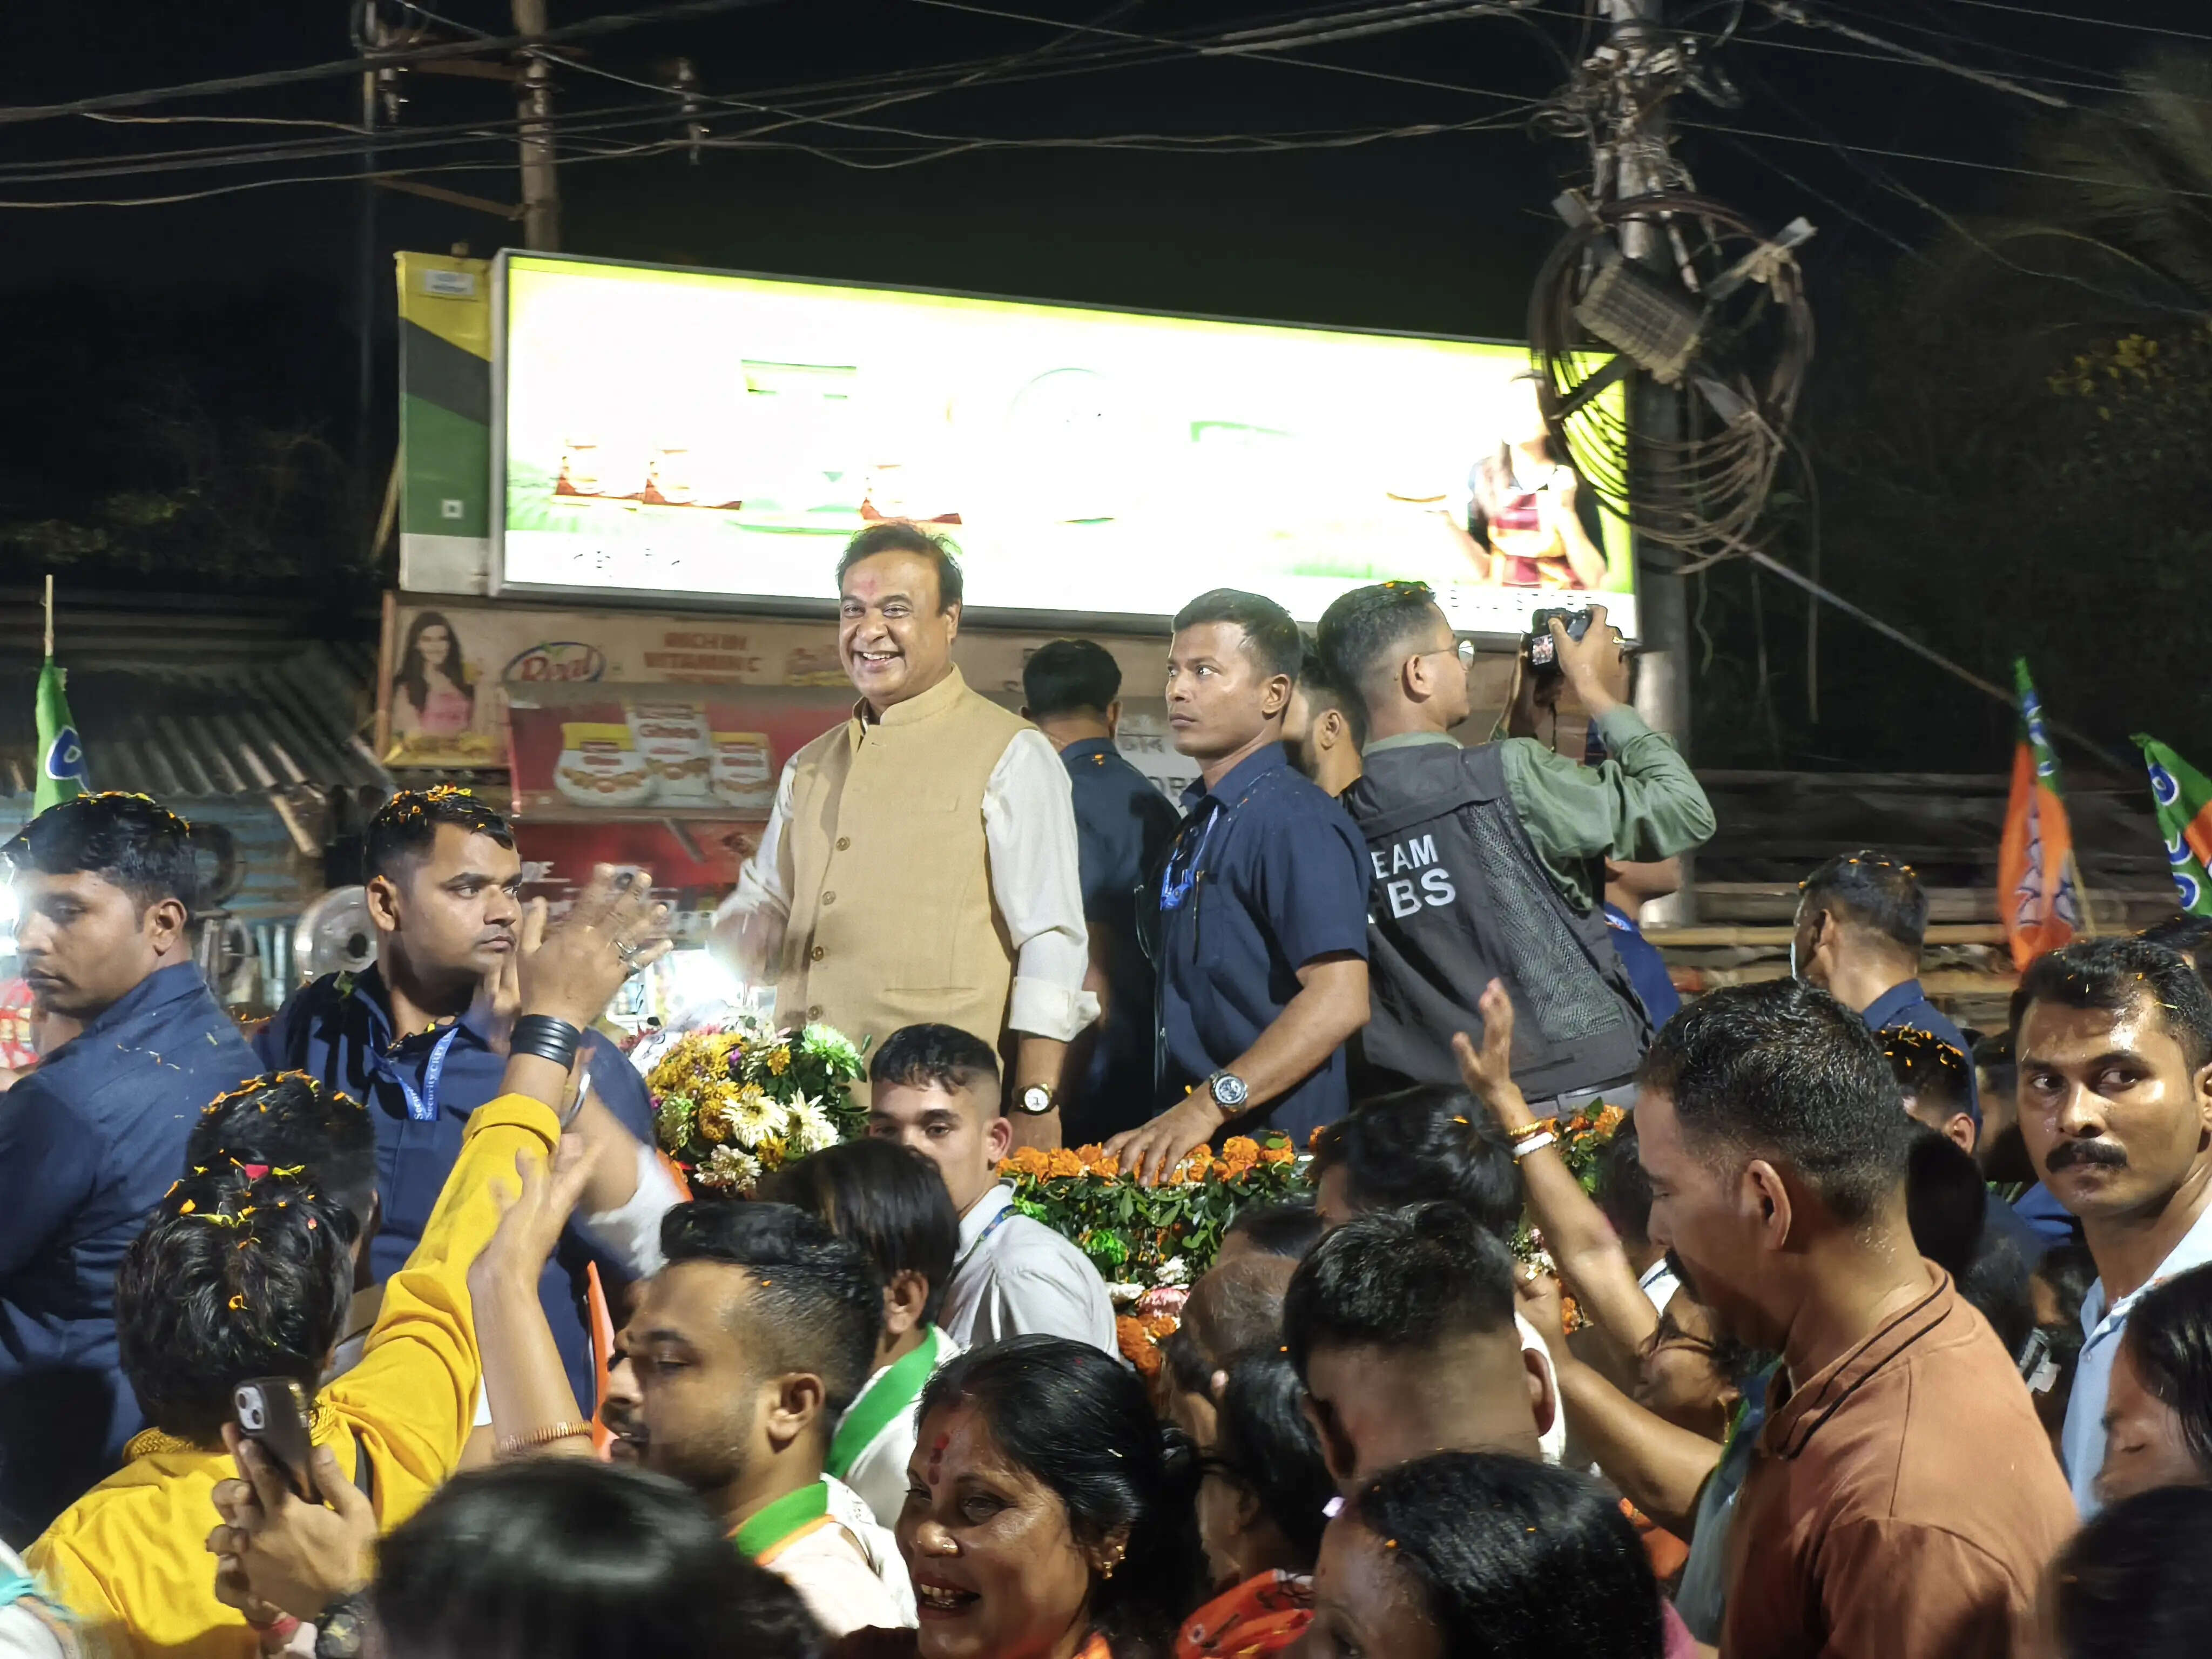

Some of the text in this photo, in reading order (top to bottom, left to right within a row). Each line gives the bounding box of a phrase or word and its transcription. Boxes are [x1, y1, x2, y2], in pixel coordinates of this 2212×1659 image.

[1371, 834, 1439, 879] EAM
[1368, 868, 1456, 923] BS
[426, 1074, 438, 1120] Security
